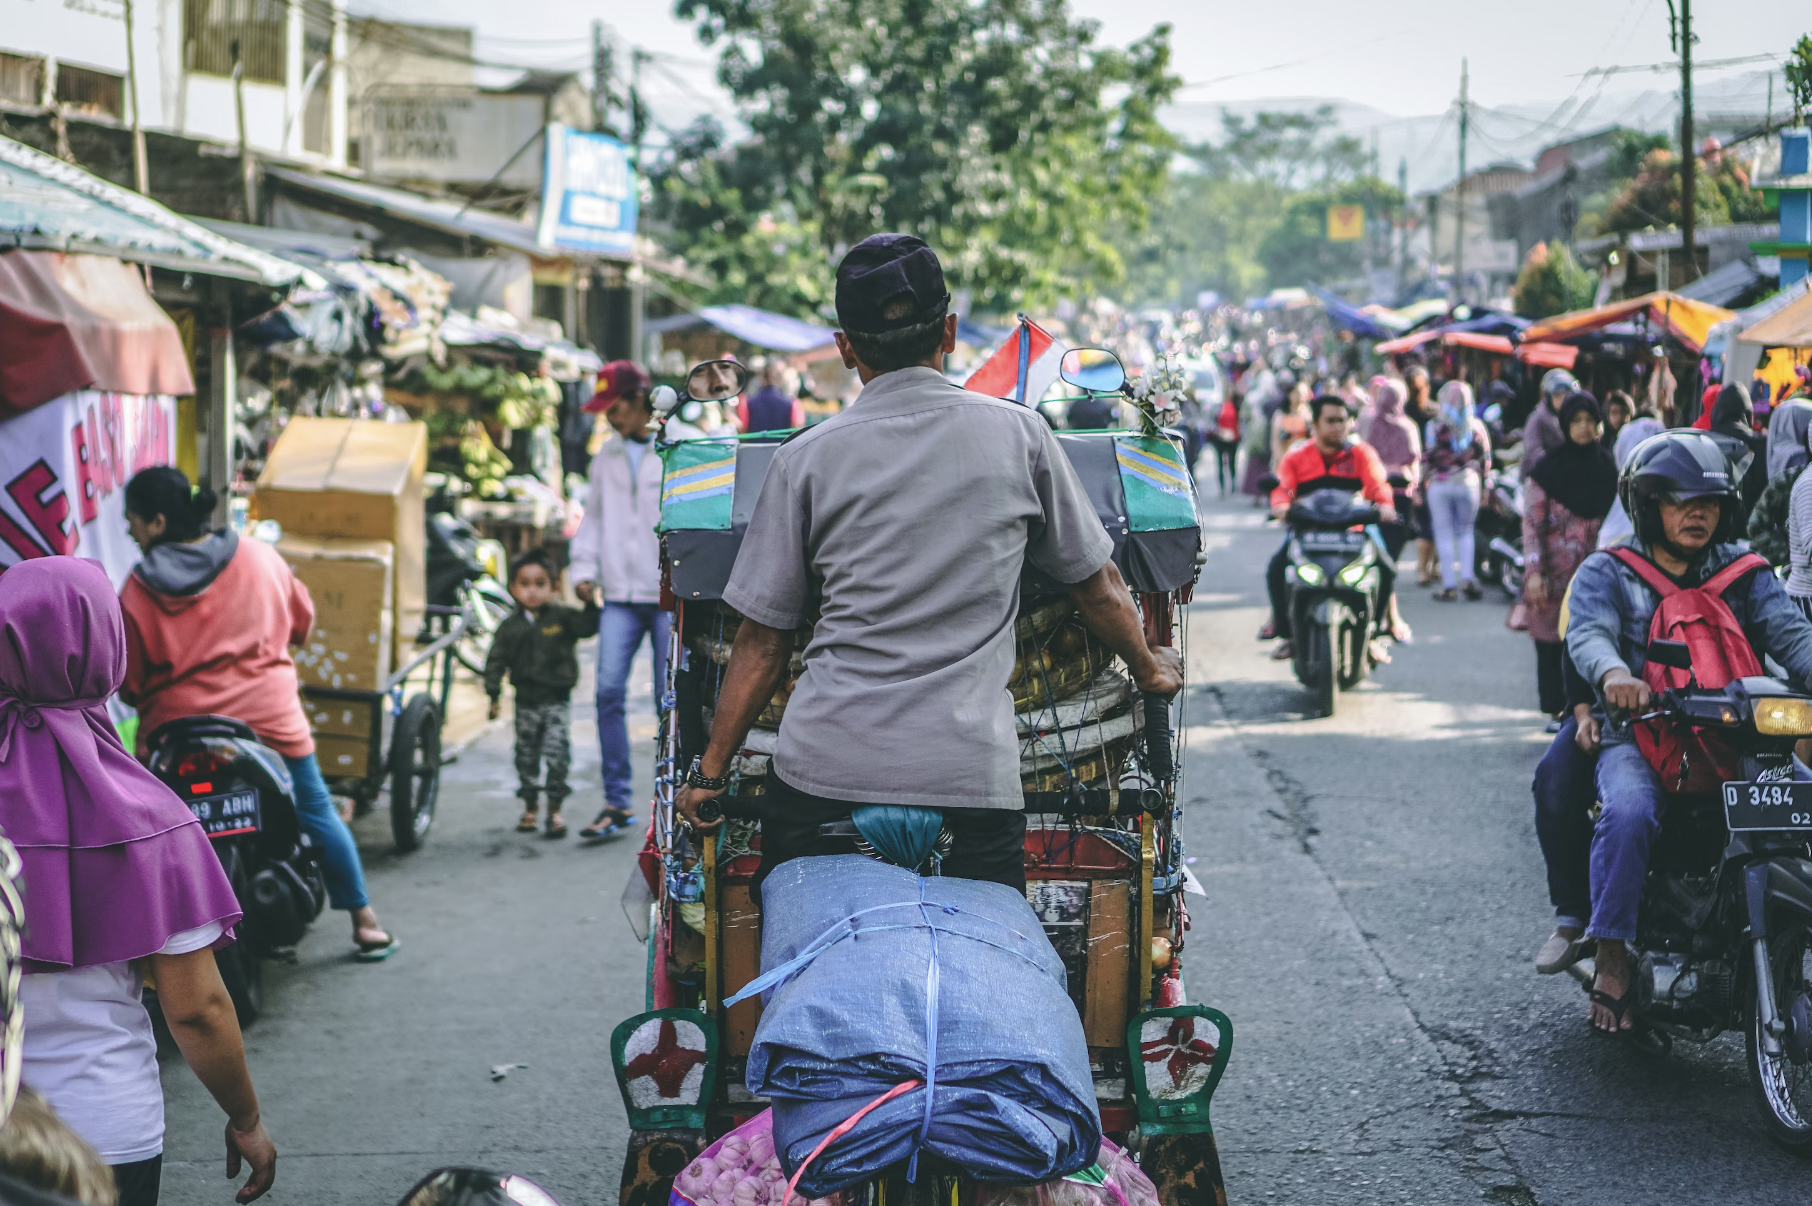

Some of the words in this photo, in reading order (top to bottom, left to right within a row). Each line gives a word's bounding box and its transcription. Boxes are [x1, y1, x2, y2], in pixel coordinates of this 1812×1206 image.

[1726, 786, 1738, 806] D
[1748, 785, 1794, 806] 3484
[1791, 812, 1811, 825] 02
